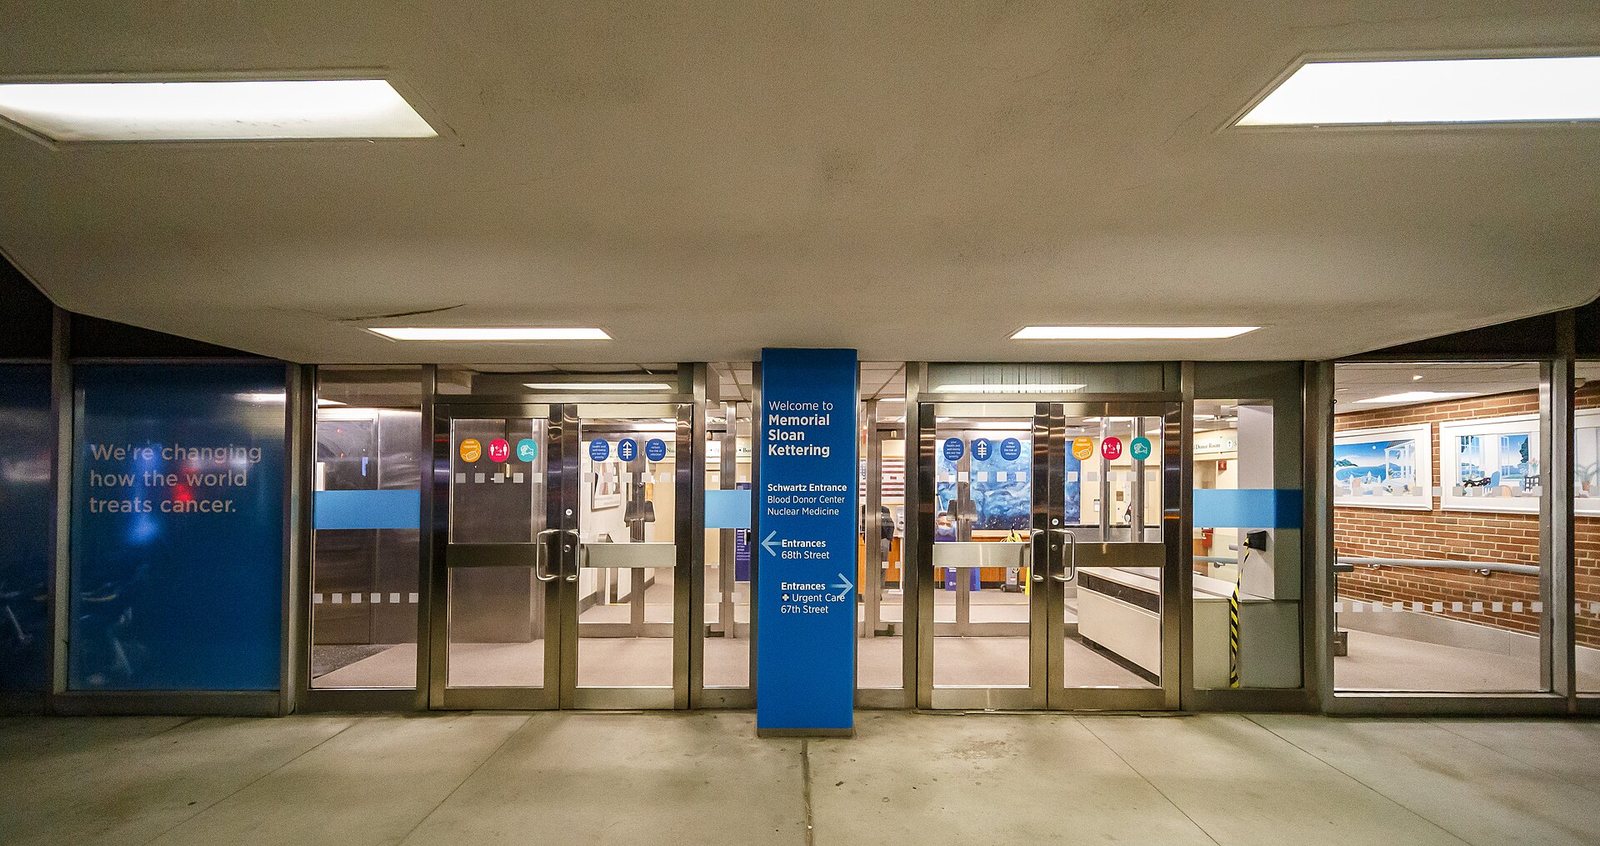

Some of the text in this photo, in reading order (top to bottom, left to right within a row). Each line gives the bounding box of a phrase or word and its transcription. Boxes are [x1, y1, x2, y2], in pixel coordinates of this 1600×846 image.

[768, 400, 834, 411] Welcome to
[768, 414, 830, 426] Memorial
[768, 429, 805, 441] Sloan
[90, 443, 262, 464] We're changing
[768, 443, 830, 457] Kettering
[90, 470, 247, 487] how the world
[767, 483, 848, 492] Schwartz Entrance
[89, 497, 237, 513] treats cancer.
[767, 495, 845, 504] Blood Donor Center
[767, 507, 840, 516] Nuclear Medicine
[781, 539, 826, 548] Entrances
[781, 550, 830, 560] 68th Street
[781, 581, 826, 591] Entrances
[792, 593, 846, 604] Urgent Care
[781, 604, 829, 614] 67th Street
